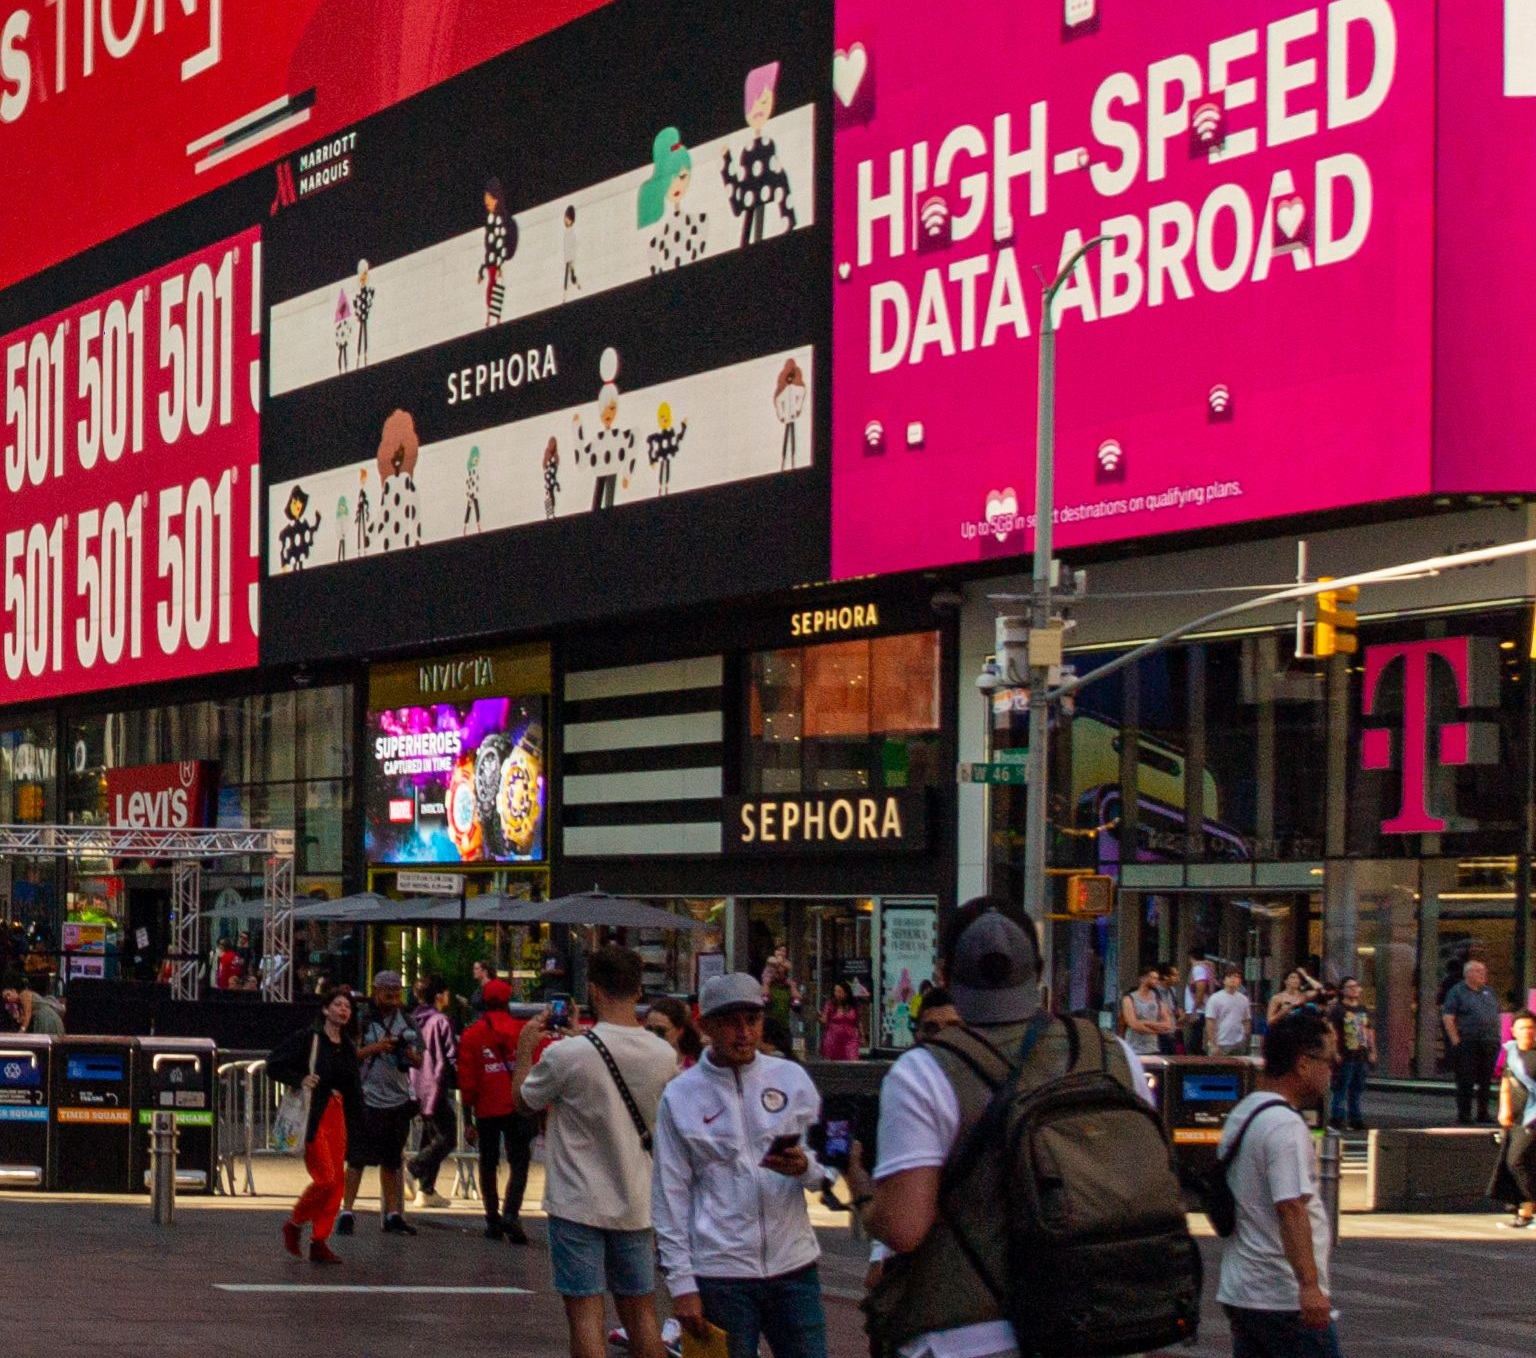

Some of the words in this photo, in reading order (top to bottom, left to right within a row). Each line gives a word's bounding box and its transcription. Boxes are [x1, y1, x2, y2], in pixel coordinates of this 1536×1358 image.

[300, 132, 356, 170] MARRIOTT
[300, 159, 350, 194] MARQUIS
[869, 248, 1030, 374] DATA
[1050, 152, 1373, 330] ABROAD
[447, 344, 557, 404] SEPHORA
[961, 521, 978, 539] Up
[979, 518, 990, 535] to
[991, 511, 1013, 533] 5GB
[1015, 511, 1024, 527] in
[1060, 496, 1128, 524] destinations
[1129, 496, 1144, 511] on
[1146, 487, 1203, 512] qualifying
[1206, 481, 1243, 504] plans.
[791, 604, 878, 636] SEPHORA
[419, 657, 494, 693] INVICTA
[375, 730, 461, 759] SUPERHEROES
[1362, 637, 1468, 833] T
[384, 760, 422, 775] CAPTURED
[423, 759, 431, 772] IN
[433, 757, 452, 772] TIME
[992, 767, 1009, 781] 46
[741, 798, 901, 843] SEPHORA
[12, 1108, 46, 1118] SQUARE
[60, 1109, 89, 1119] TIMES
[93, 1109, 128, 1119] SQUARE
